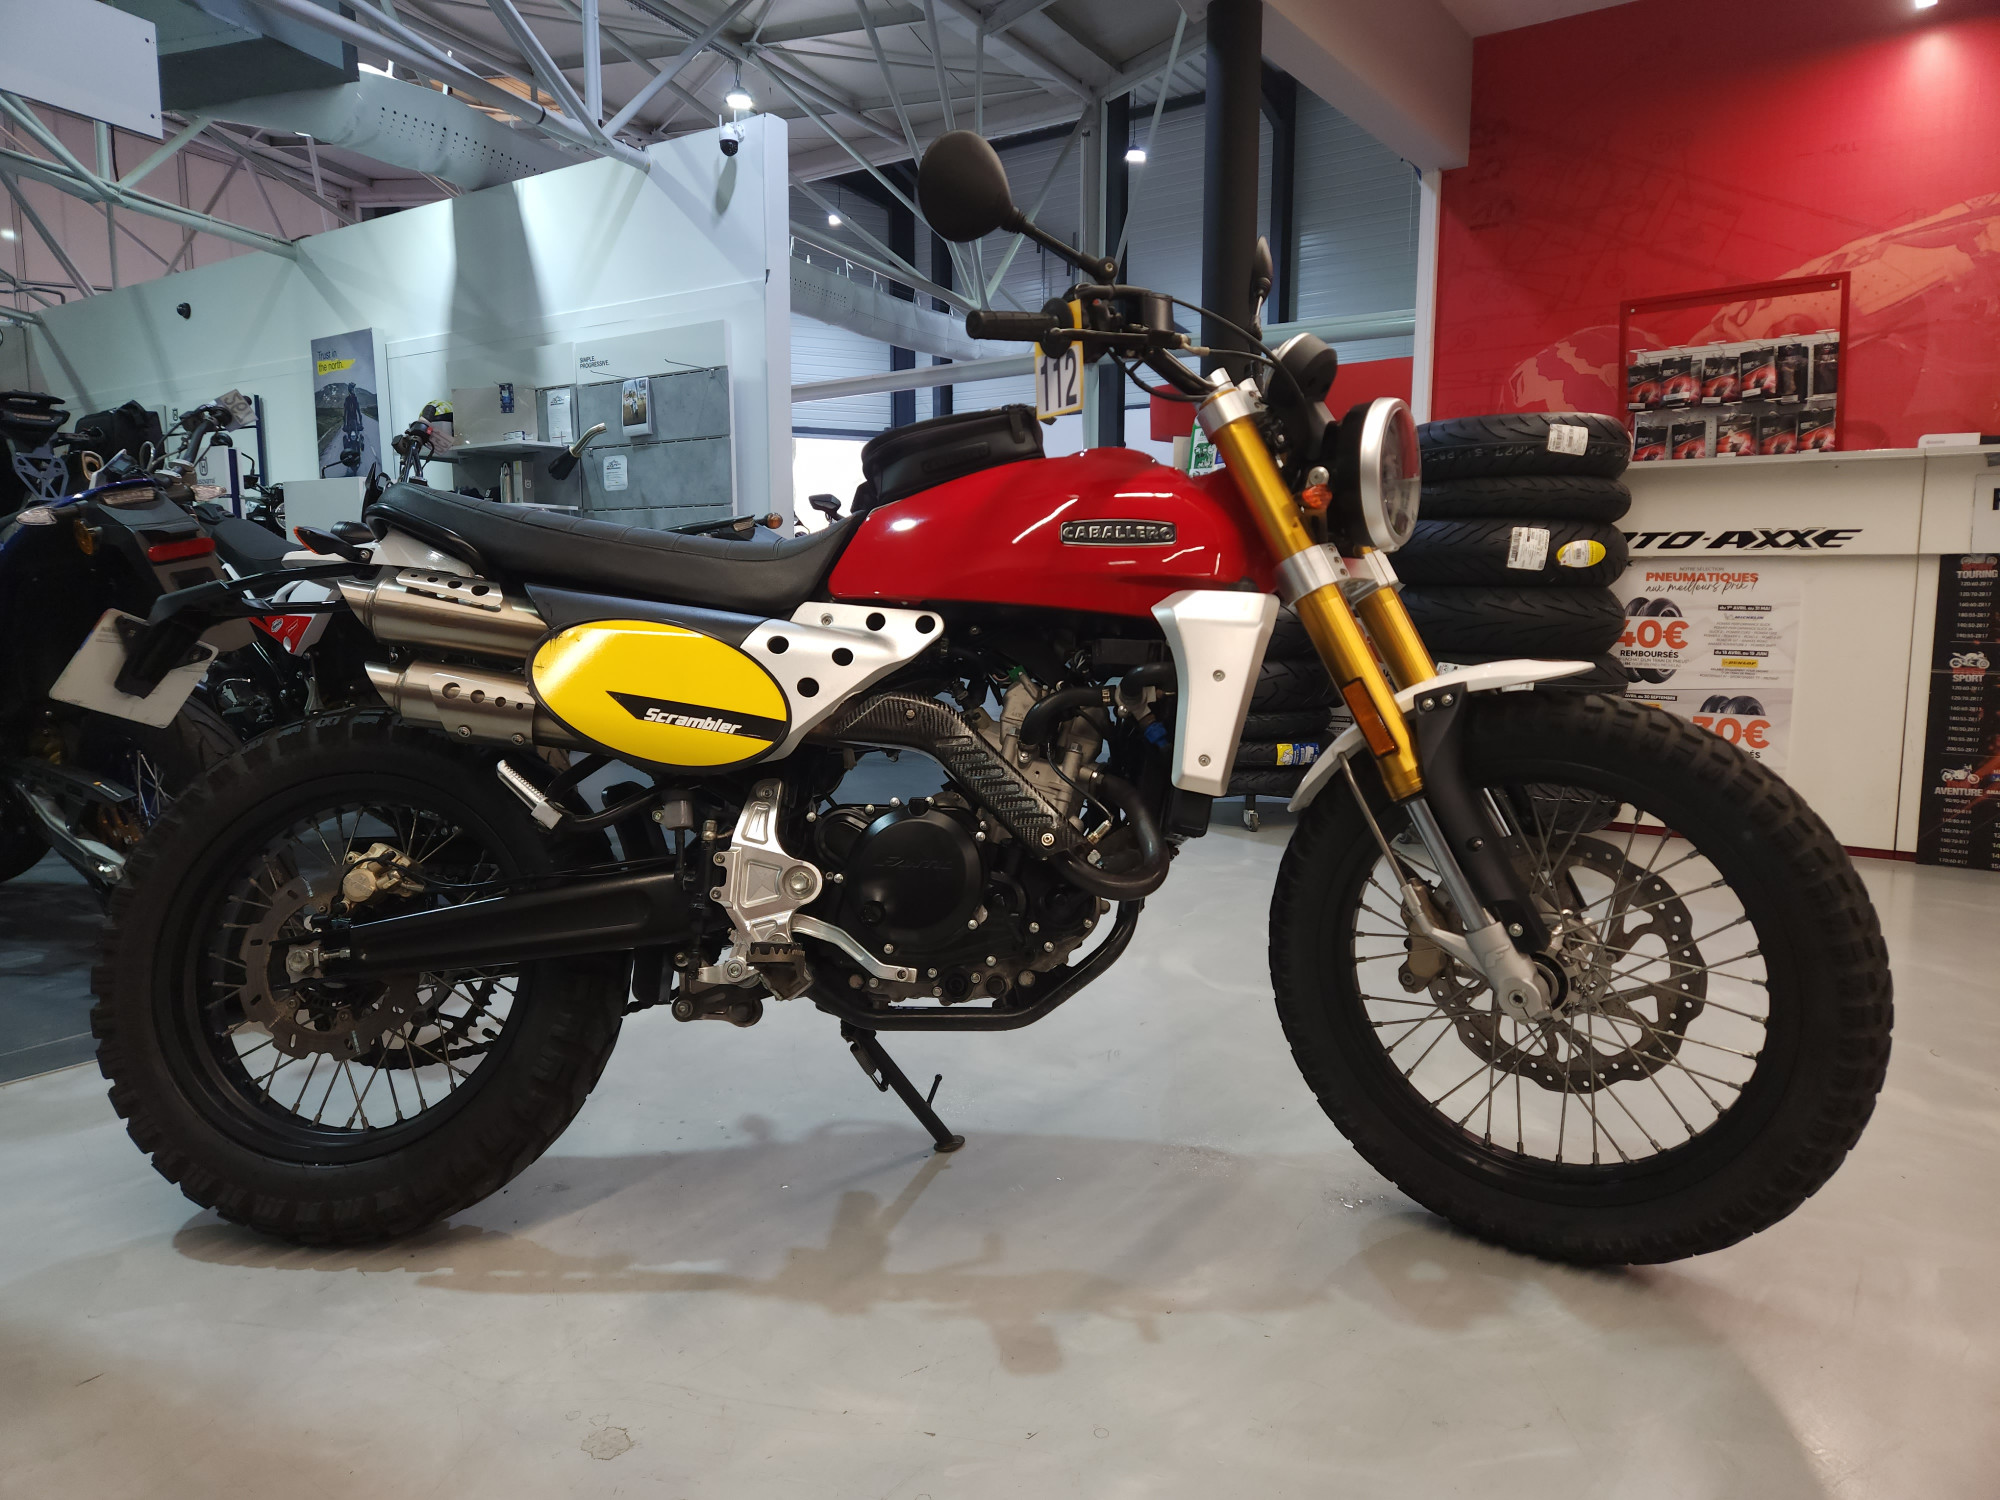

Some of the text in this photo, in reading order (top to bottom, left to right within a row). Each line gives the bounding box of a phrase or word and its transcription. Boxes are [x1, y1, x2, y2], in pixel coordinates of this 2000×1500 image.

[316, 349, 338, 361] Trust in
[318, 361, 344, 373] the north.
[1040, 347, 1078, 411] 112
[1062, 525, 1174, 540] CABALLERO
[1622, 527, 1863, 551] TO-AXXE
[1645, 571, 1760, 584] PNEUMATIQUES
[1956, 569, 1999, 579] TOURING
[1645, 584, 1665, 593] aux
[1666, 578, 1720, 596] meilleurs
[1721, 580, 1748, 595] prix
[1616, 619, 1690, 650] 40€
[1620, 649, 1679, 658] REMBOURSÉS
[1952, 674, 1985, 682] SPORT
[643, 707, 742, 734] Scrambler
[1934, 786, 1984, 797] AVENTURE
